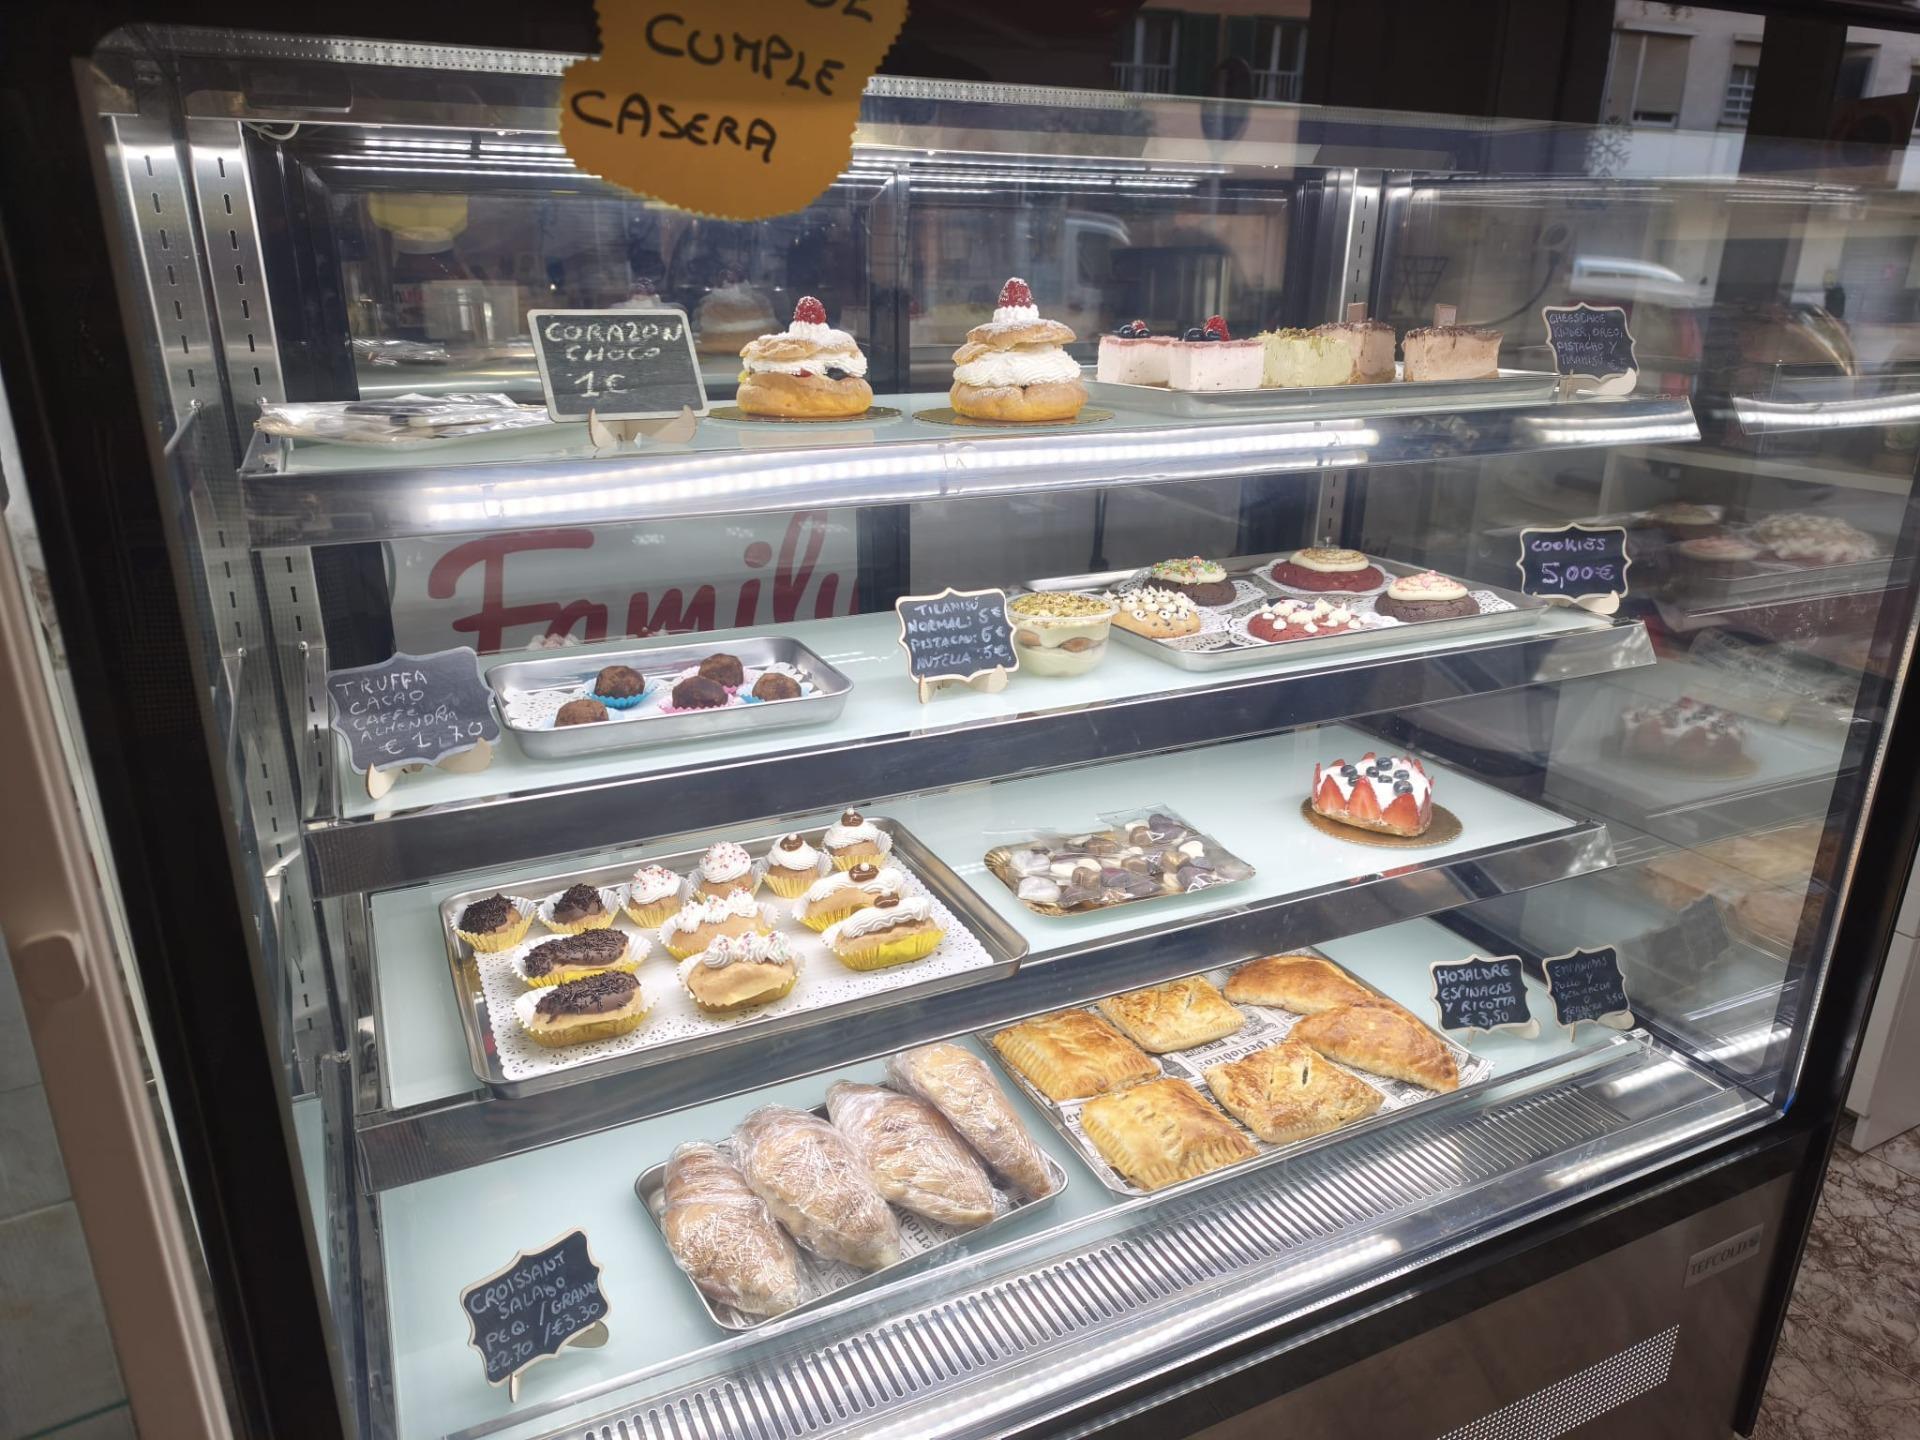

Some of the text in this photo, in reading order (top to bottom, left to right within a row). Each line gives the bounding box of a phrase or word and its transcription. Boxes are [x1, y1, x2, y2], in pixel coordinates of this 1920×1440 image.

[645, 13, 845, 96] CUMPLE
[570, 90, 777, 164] CASERA
[545, 322, 683, 342] CORAZON
[566, 345, 661, 361] CHOCO
[1609, 341, 1618, 354] Y
[336, 670, 428, 696] TRUFFA
[350, 690, 424, 715] CACAO
[361, 704, 459, 744] ALMENDRA
[1437, 964, 1511, 985] HOJALDRE
[1441, 982, 1512, 1001] ESPINACAS
[1444, 996, 1516, 1013] Y RICOTTA
[1478, 1009, 1509, 1026] 3,50
[471, 1250, 567, 1314] CROISSANT
[498, 1276, 565, 1320] SALADO
[485, 1320, 530, 1352] PEQ.
